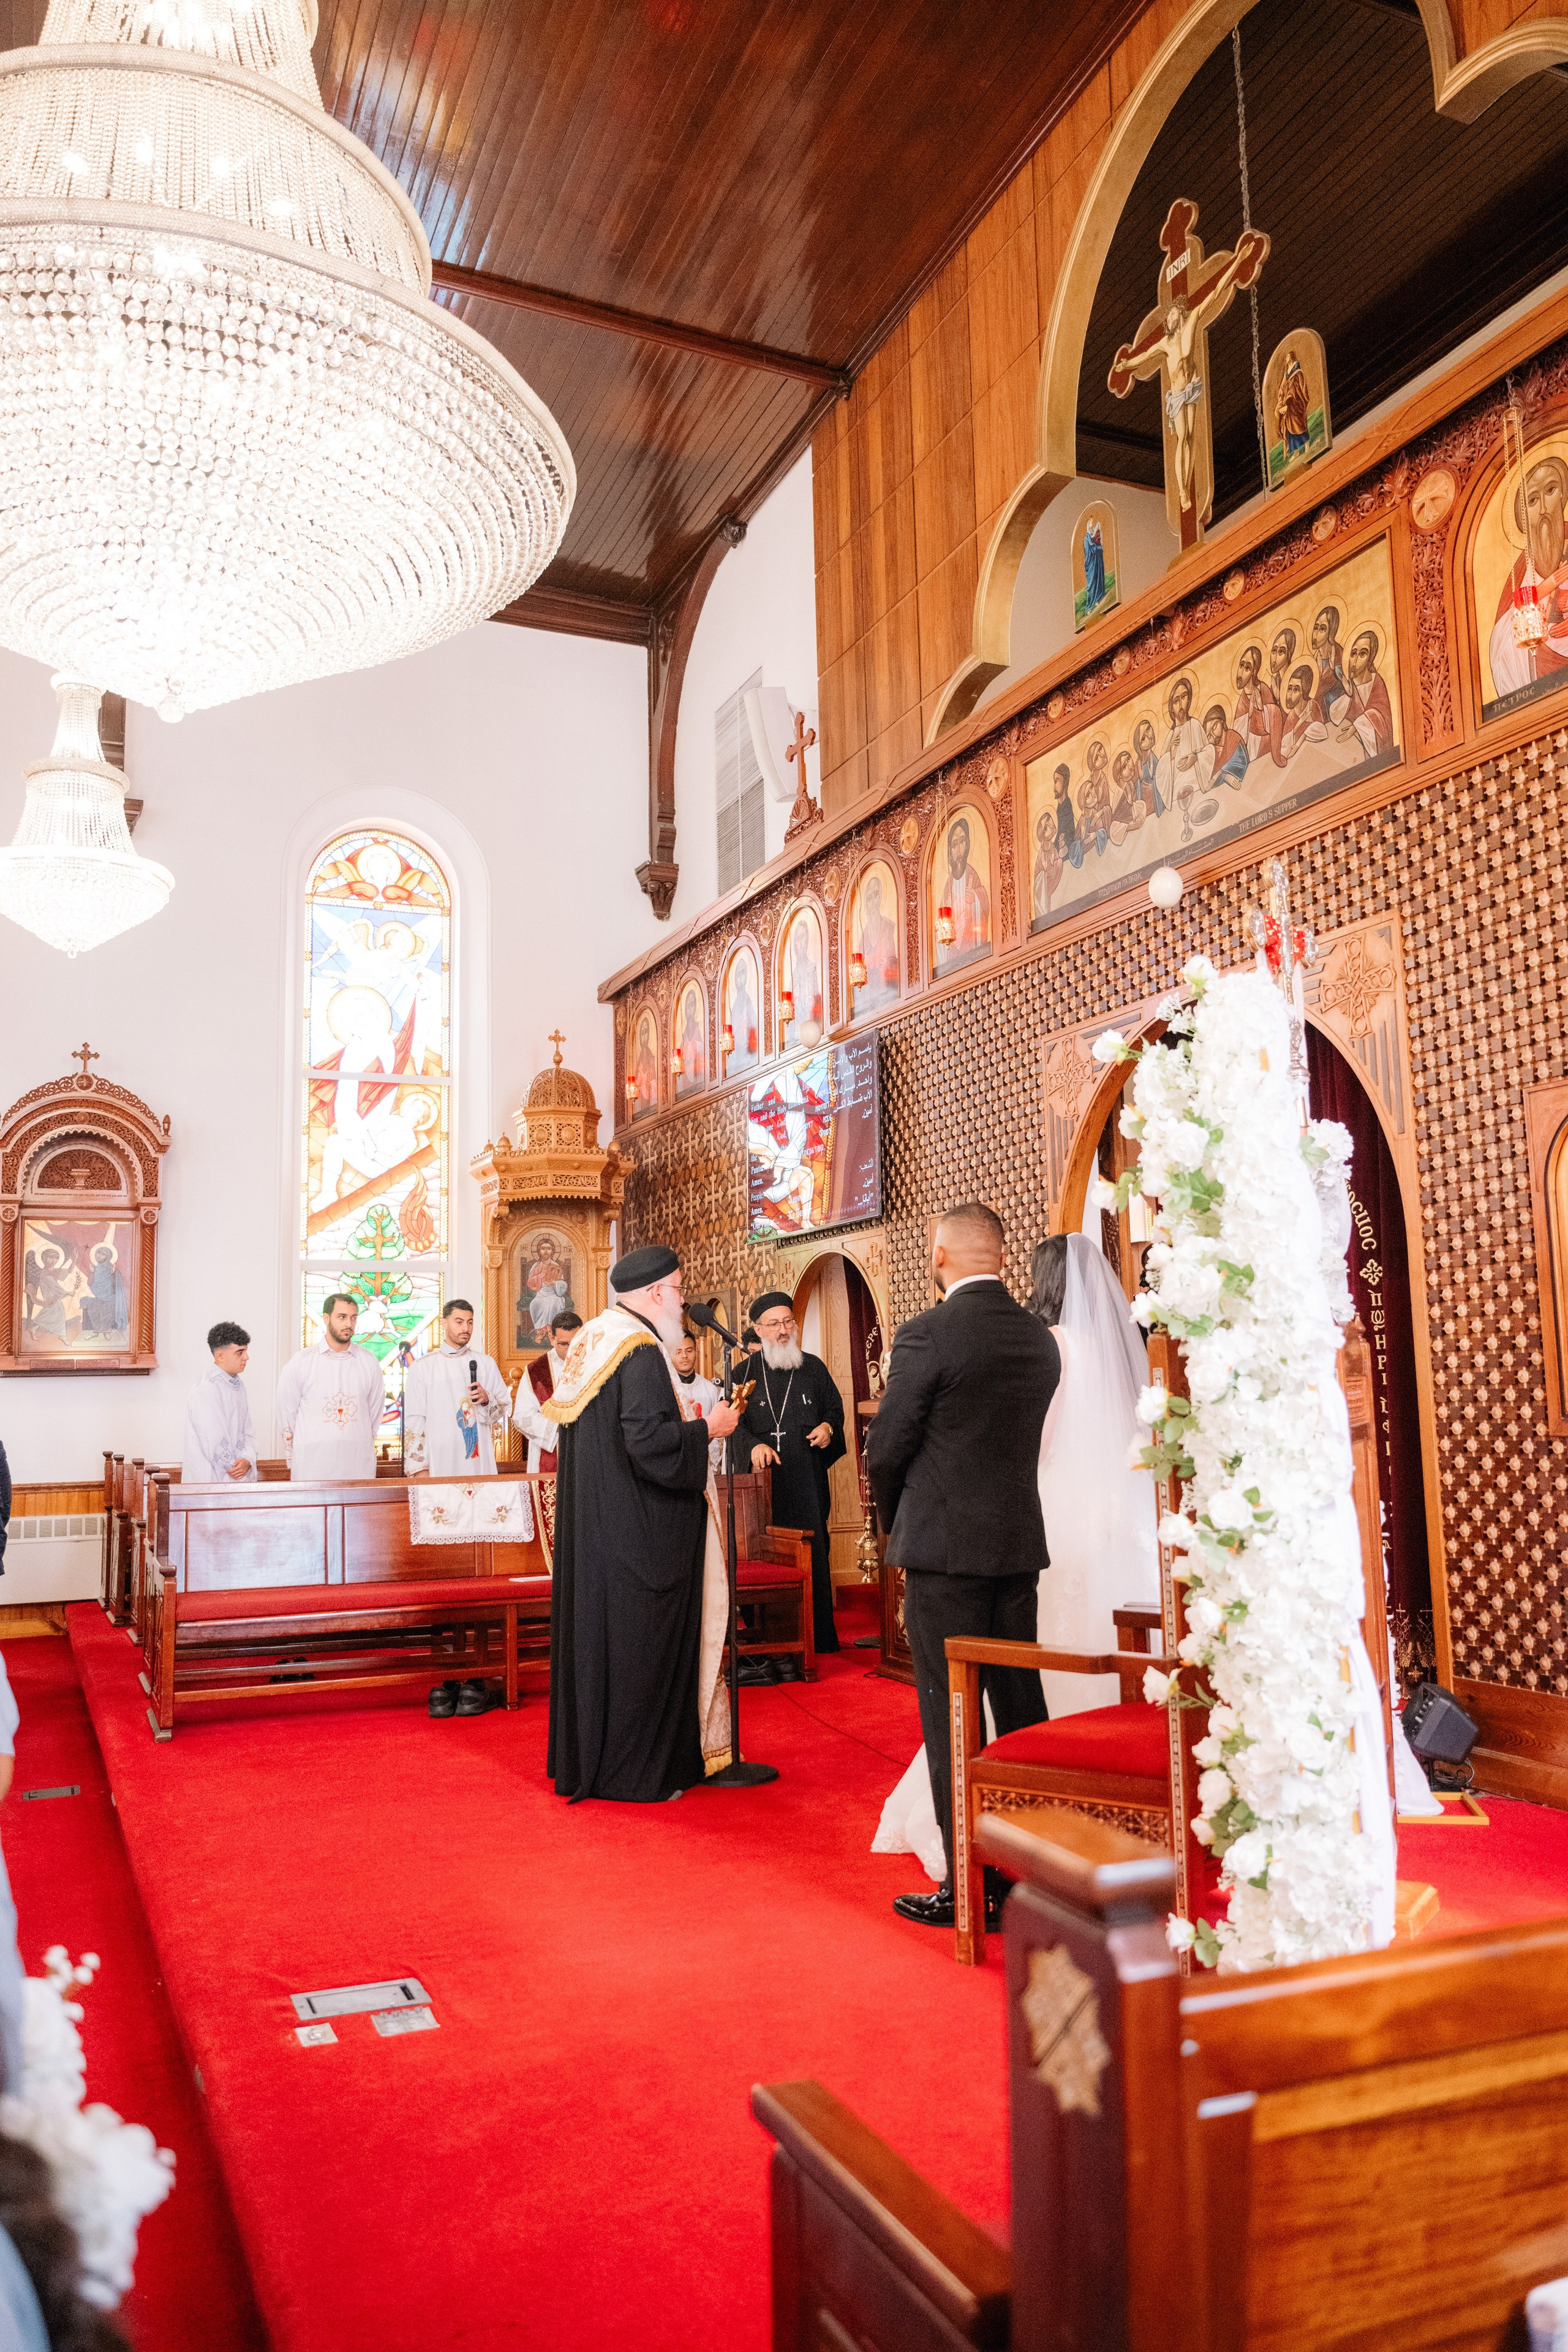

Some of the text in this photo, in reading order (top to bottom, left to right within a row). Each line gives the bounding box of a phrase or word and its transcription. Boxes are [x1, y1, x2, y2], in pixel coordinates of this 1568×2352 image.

[1169, 251, 1188, 278] INRI
[1239, 820, 1251, 833] THE
[1274, 798, 1297, 816] SUPPER
[974, 945, 990, 959] JOHN
[849, 1047, 858, 1061] الآب
[858, 1042, 872, 1059] باسم
[840, 1064, 854, 1080] القدس
[855, 1059, 872, 1076] والروح
[839, 1082, 856, 1096] مبارك
[863, 1089, 873, 1102] الآب
[847, 1093, 863, 1107] ضابط
[750, 1102, 764, 1113] Father
[777, 1105, 787, 1115] Holy
[862, 1103, 873, 1120] آمين.
[777, 1130, 788, 1141] God,
[751, 1178, 764, 1187] Amen.
[862, 1172, 874, 1188] آمين.
[751, 1207, 764, 1216] Amen.
